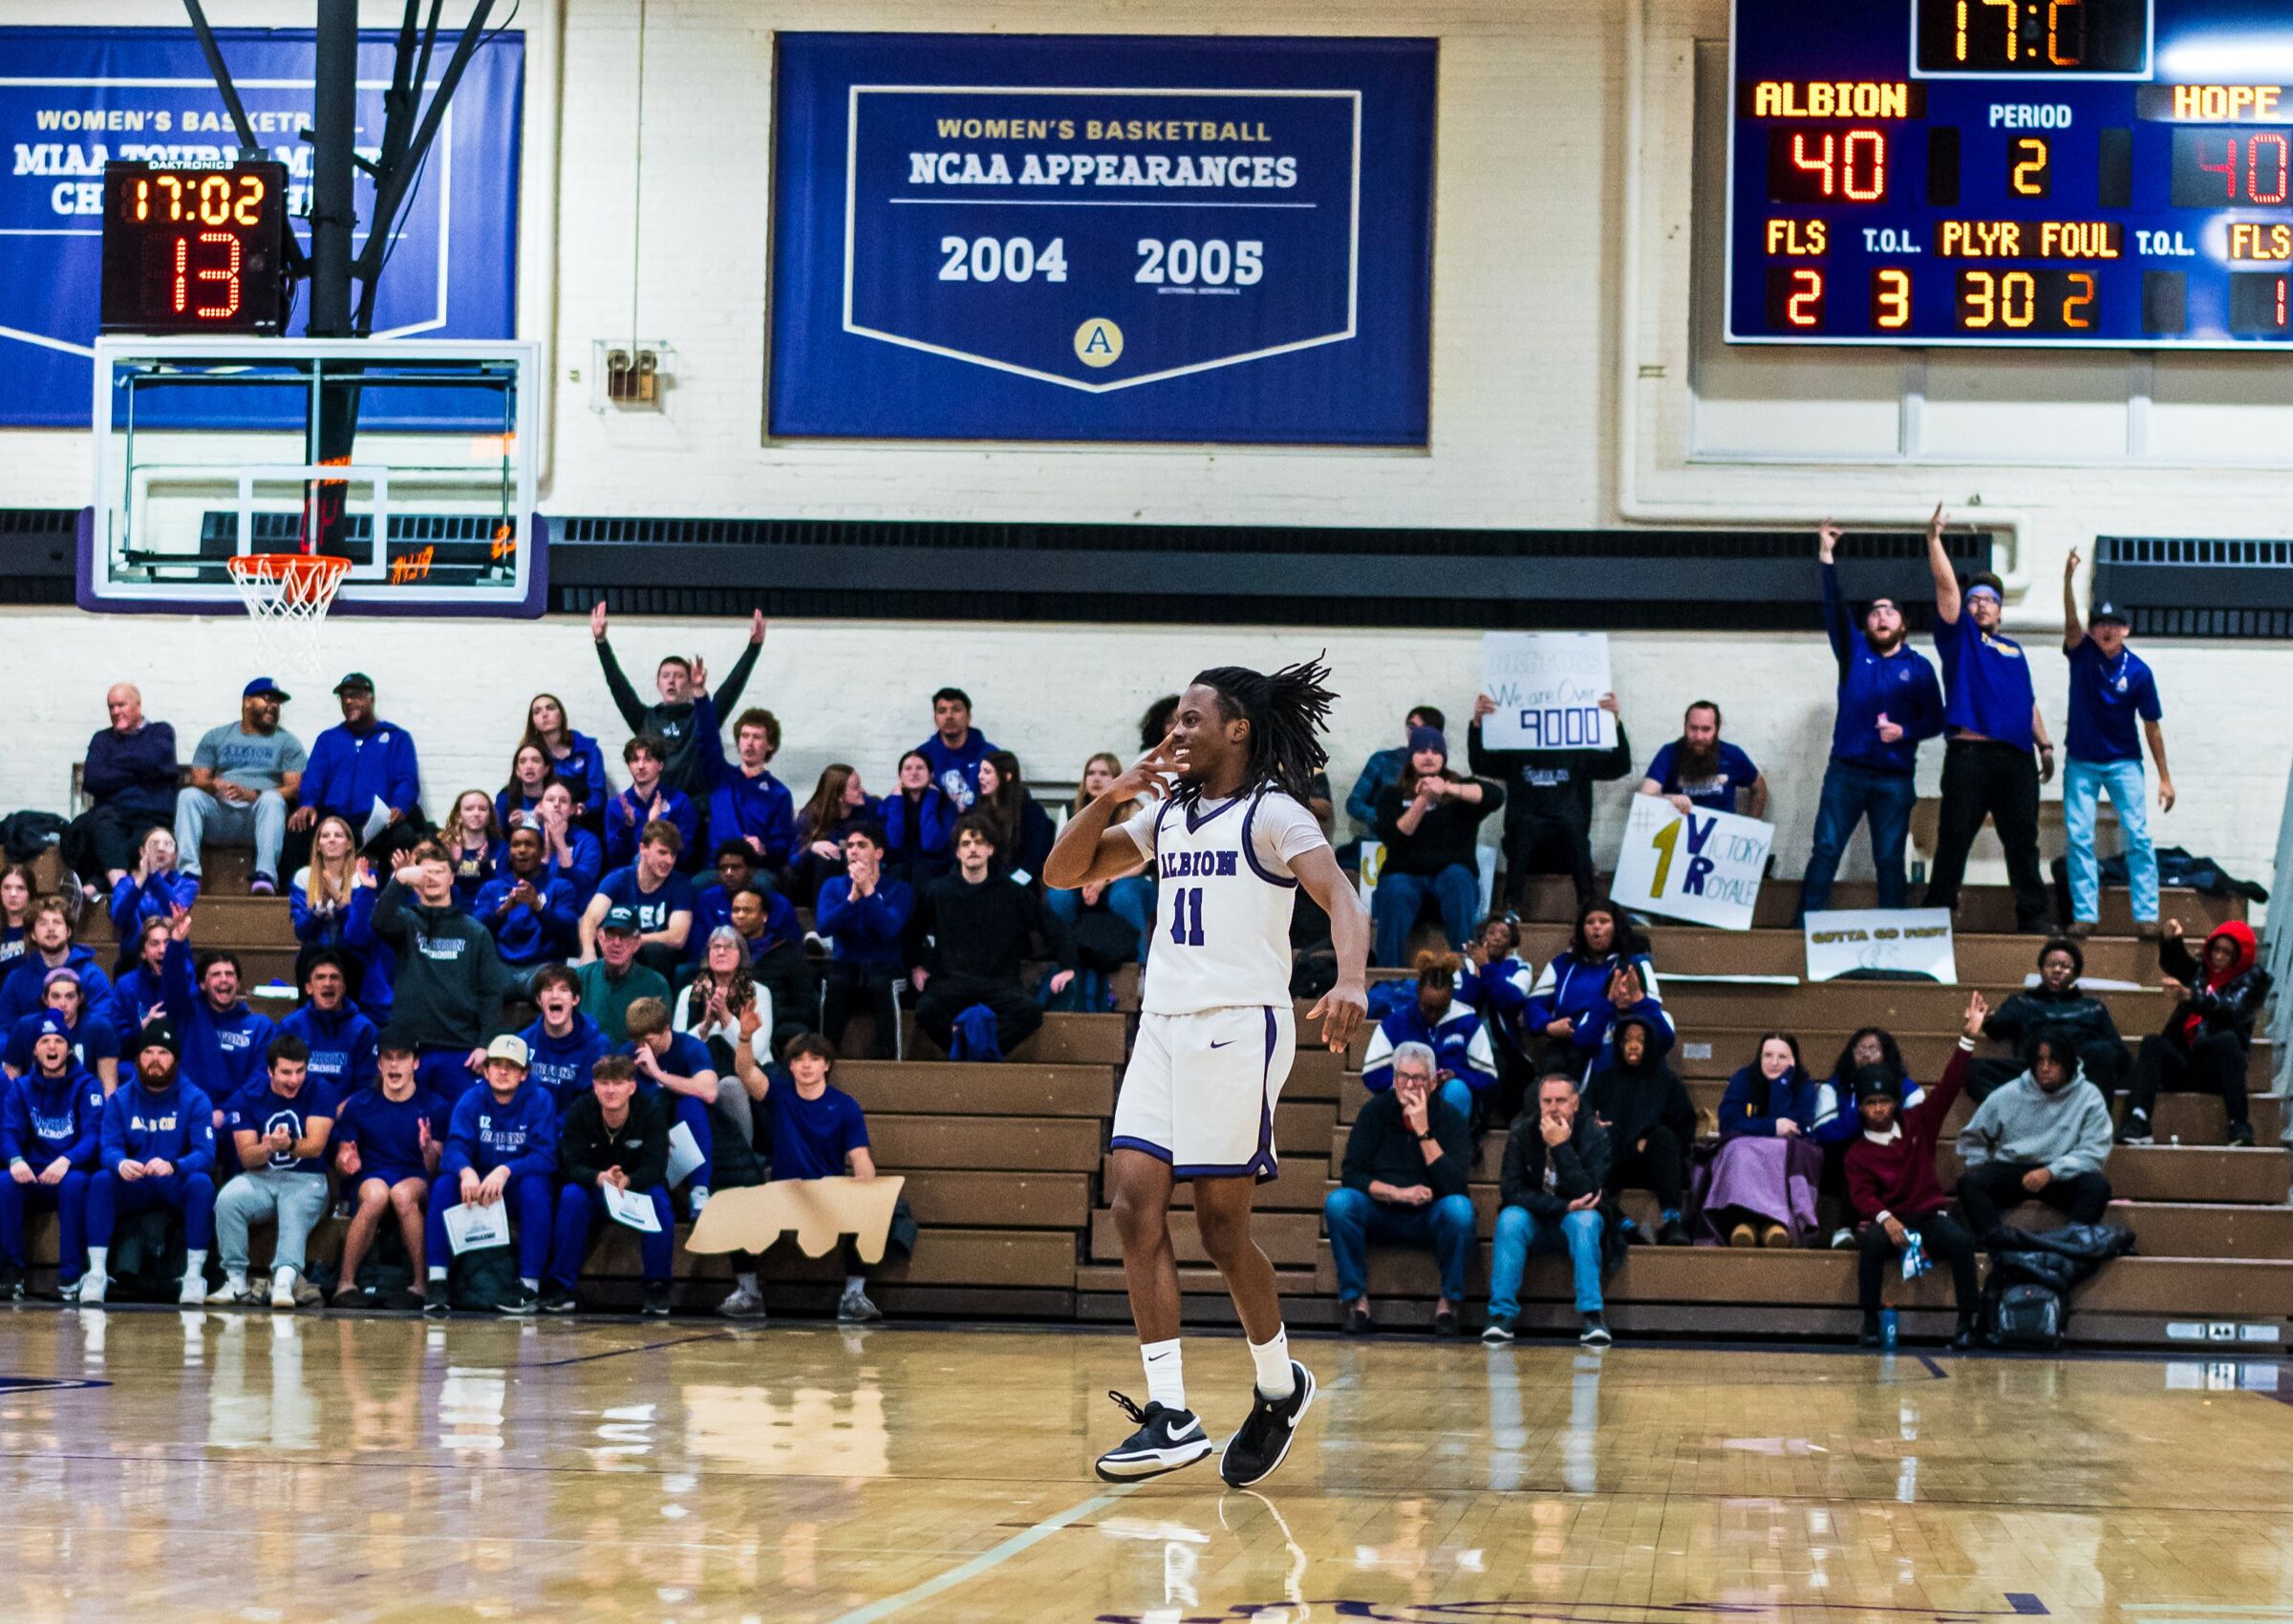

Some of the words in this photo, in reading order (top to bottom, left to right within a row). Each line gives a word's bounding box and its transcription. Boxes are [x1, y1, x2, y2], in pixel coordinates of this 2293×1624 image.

[1755, 82, 1907, 117] ALBION
[1989, 105, 2071, 128] PERIOD
[2174, 85, 2282, 119] HOPE
[36, 110, 173, 132] WOMEN'S
[936, 118, 1076, 139] WOMEN'S
[1086, 120, 1272, 141] BASKETBALL
[13, 143, 110, 176] MIAA
[148, 160, 234, 170] DAKTRONICS
[909, 153, 1013, 184] NCAA
[1018, 154, 1297, 188] APPEARANCES
[1793, 131, 1884, 200] 40
[2014, 139, 2047, 194] 2
[2199, 134, 2287, 203] 40
[137, 175, 265, 226] 17:02
[1767, 220, 1826, 255] FLS
[1862, 229, 1921, 252] T.O.L.
[1943, 222, 2020, 256] PLYR
[2042, 223, 2118, 258] FOUL
[2136, 231, 2196, 256] T.O.L.
[2232, 224, 2292, 259] FLS
[175, 232, 241, 317] 13
[938, 237, 1067, 283] 2004
[1134, 239, 1263, 285] 2005
[1789, 271, 1821, 325] 2
[1877, 270, 1909, 327] 3
[1964, 272, 2035, 328] 30
[2063, 274, 2094, 328] 2
[2276, 279, 2285, 326] 1
[1084, 327, 1112, 353] A
[1489, 682, 1523, 707] We
[1529, 688, 1554, 705] are
[1558, 679, 1595, 704] Over
[1521, 708, 1600, 747] 9000
[1687, 813, 1767, 865] VICTORY
[1682, 856, 1757, 907] ROYALE
[1170, 887, 1204, 946] 11
[1811, 930, 1868, 944] GOTTA
[1874, 928, 1899, 939] GO
